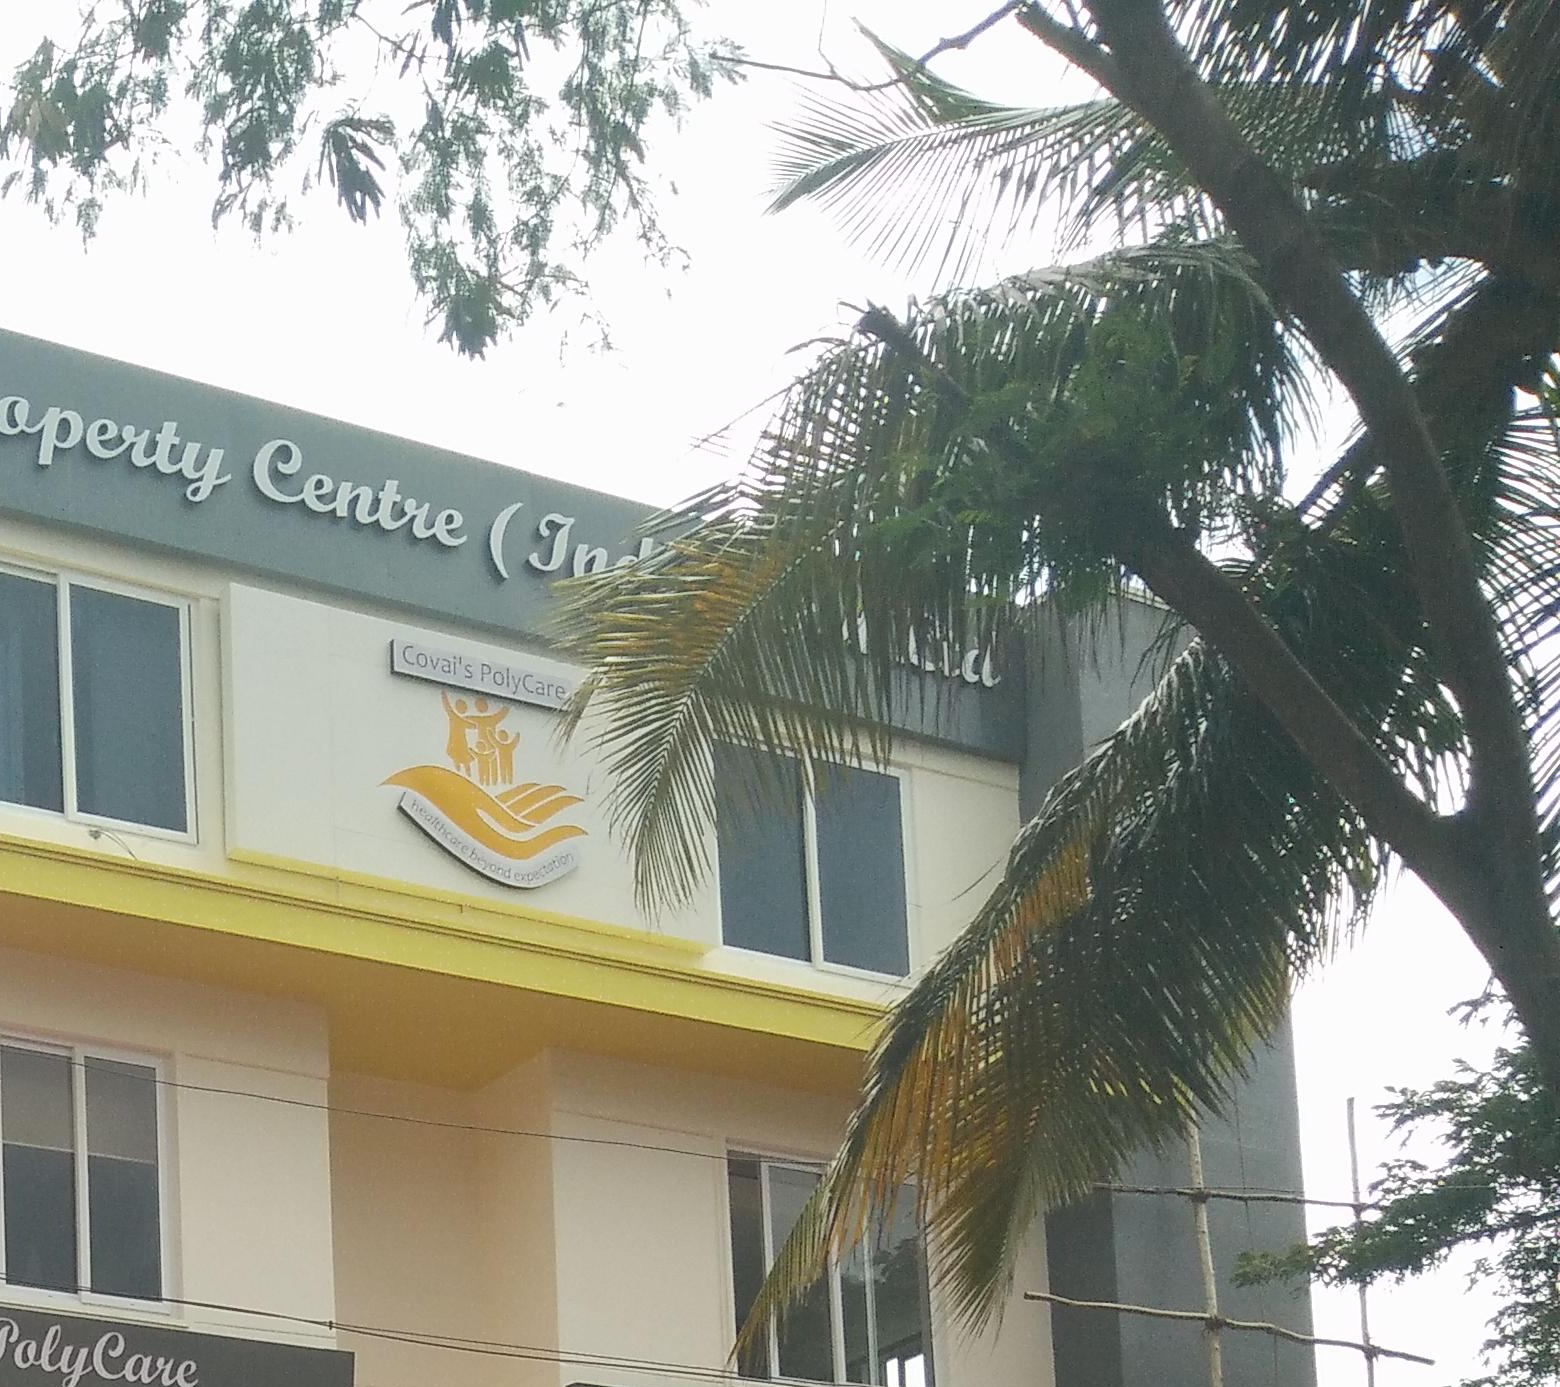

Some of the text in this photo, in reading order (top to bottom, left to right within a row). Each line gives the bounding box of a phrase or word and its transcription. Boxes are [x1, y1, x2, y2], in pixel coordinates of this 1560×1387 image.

[252, 437, 470, 550] Centre
[401, 644, 567, 701] Covai's PolyCare
[410, 798, 575, 883] healthcare beyond expectation
